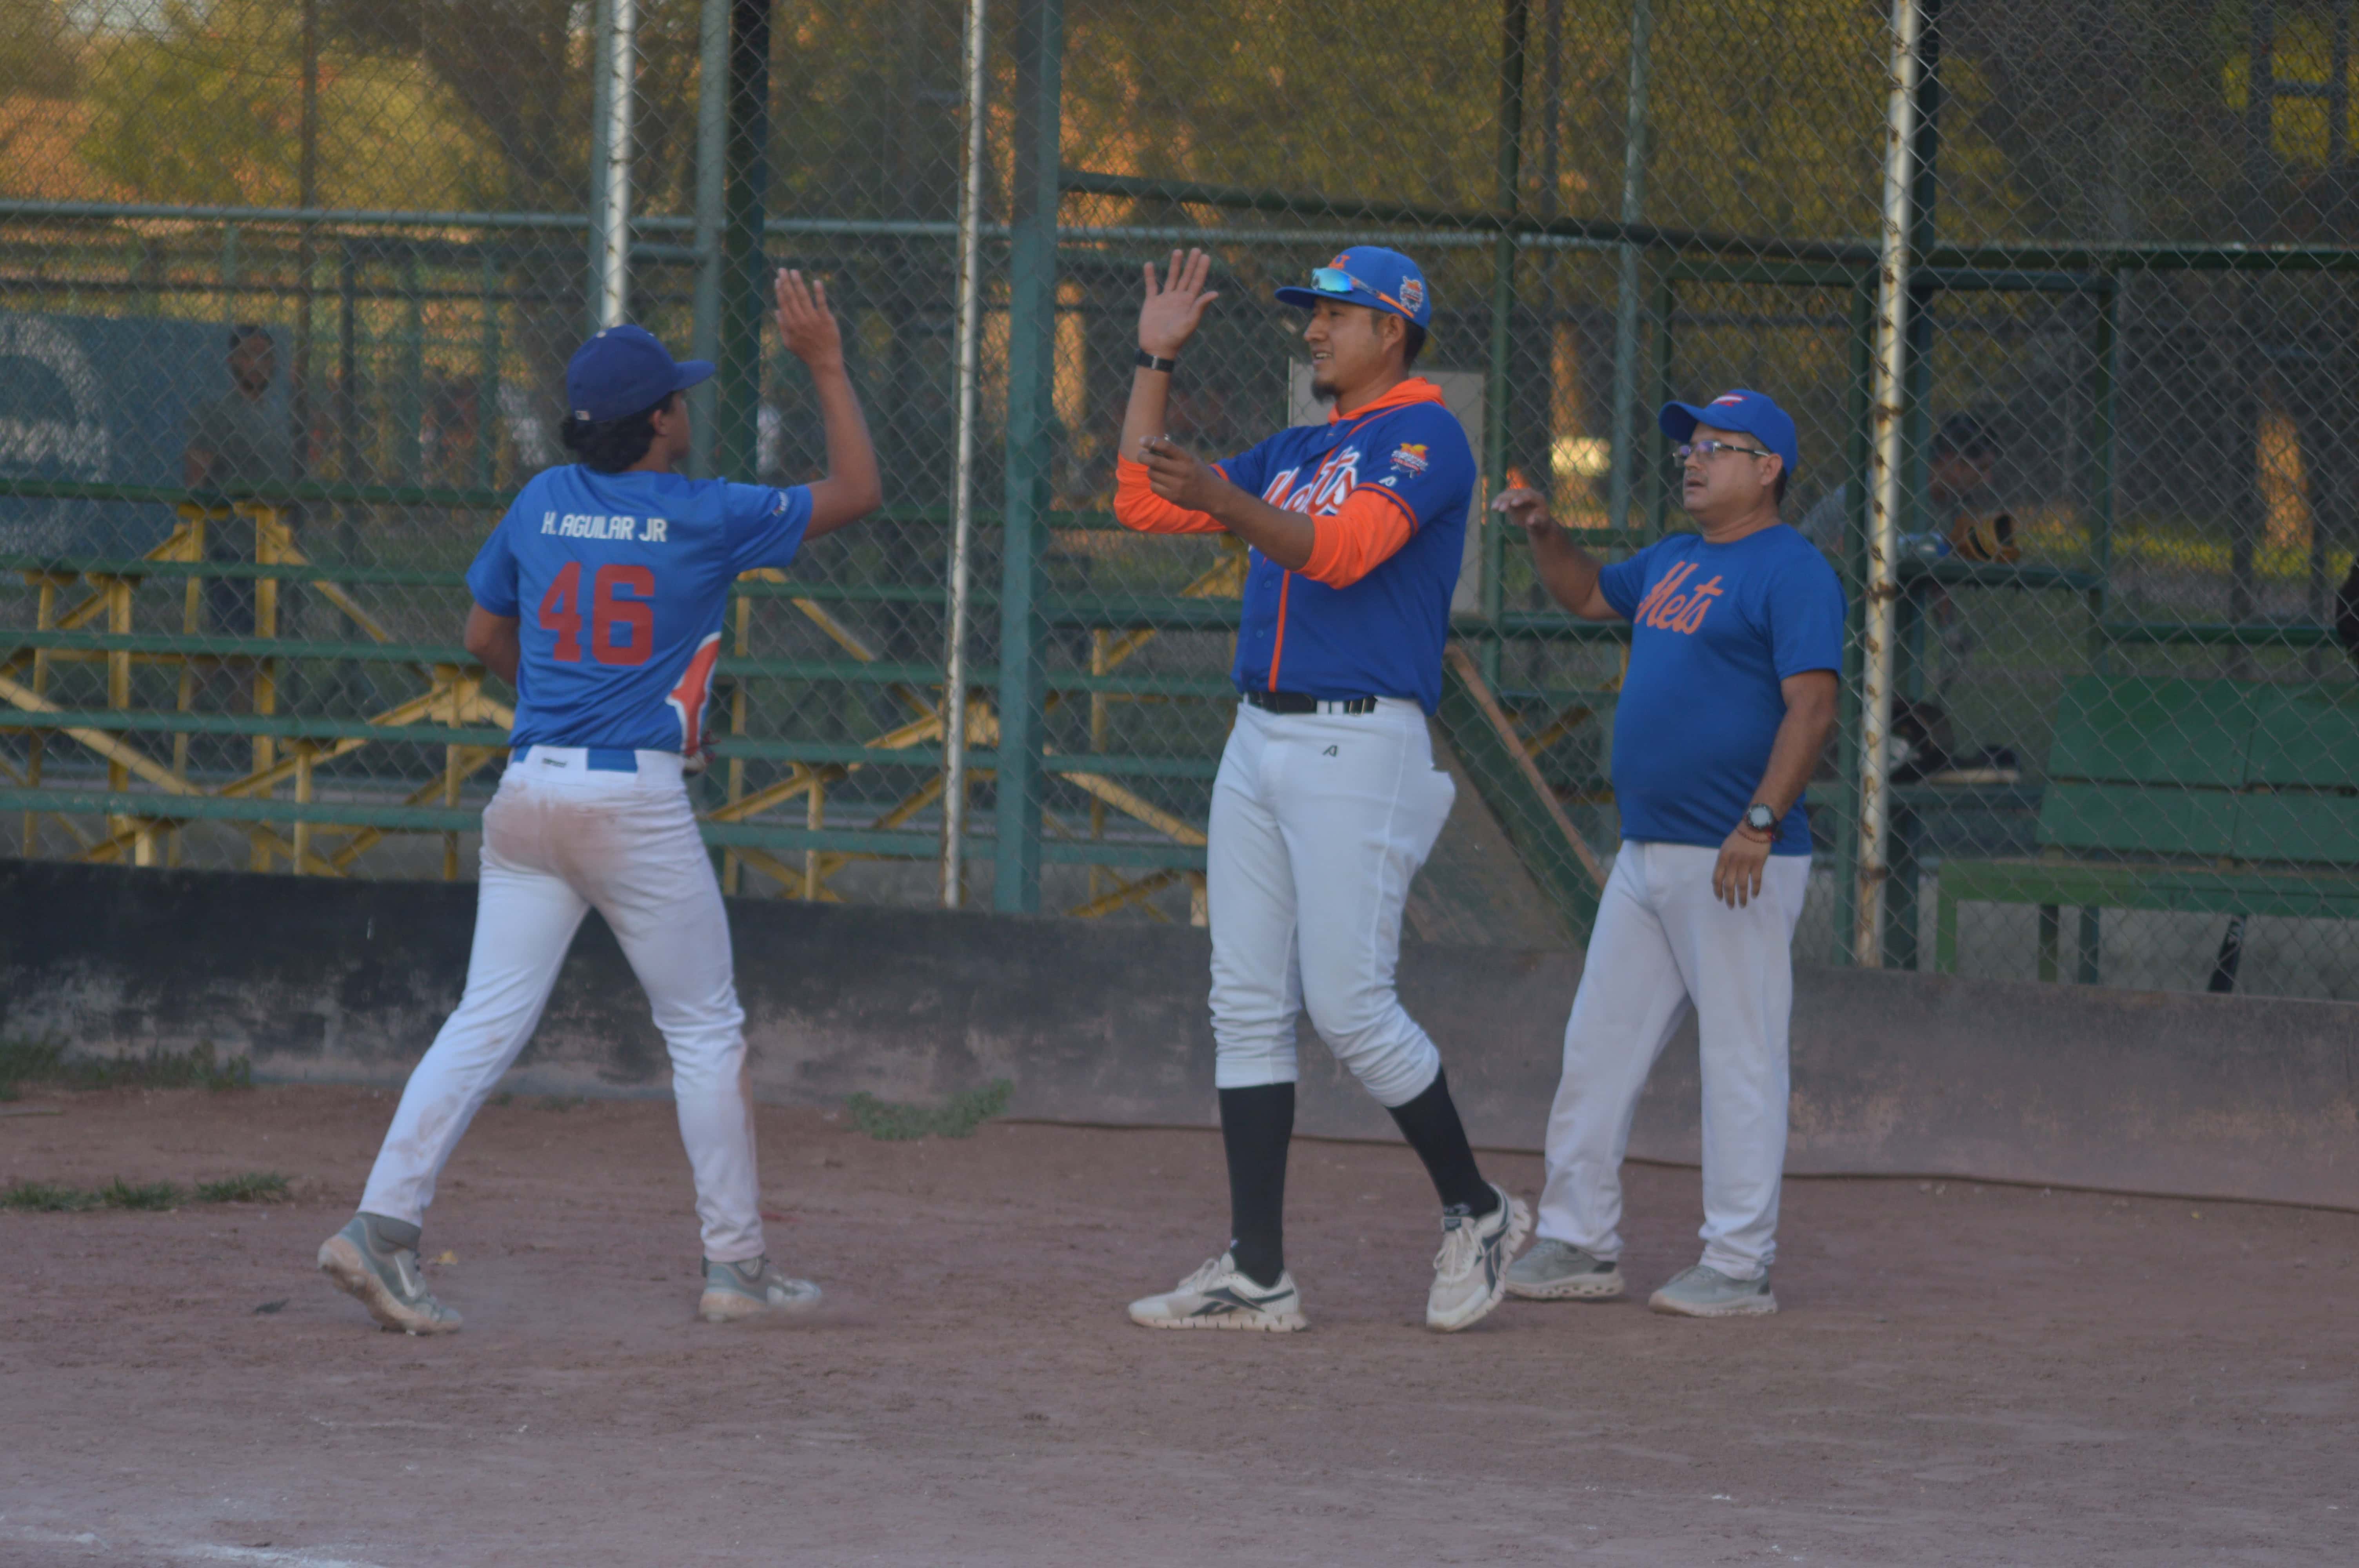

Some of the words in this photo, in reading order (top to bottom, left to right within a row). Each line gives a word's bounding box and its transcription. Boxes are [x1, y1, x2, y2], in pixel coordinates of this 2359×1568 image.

[558, 514, 634, 540] AGUILAR
[638, 517, 667, 542] JR
[538, 561, 655, 666] 46
[1634, 561, 1724, 635] Mets
